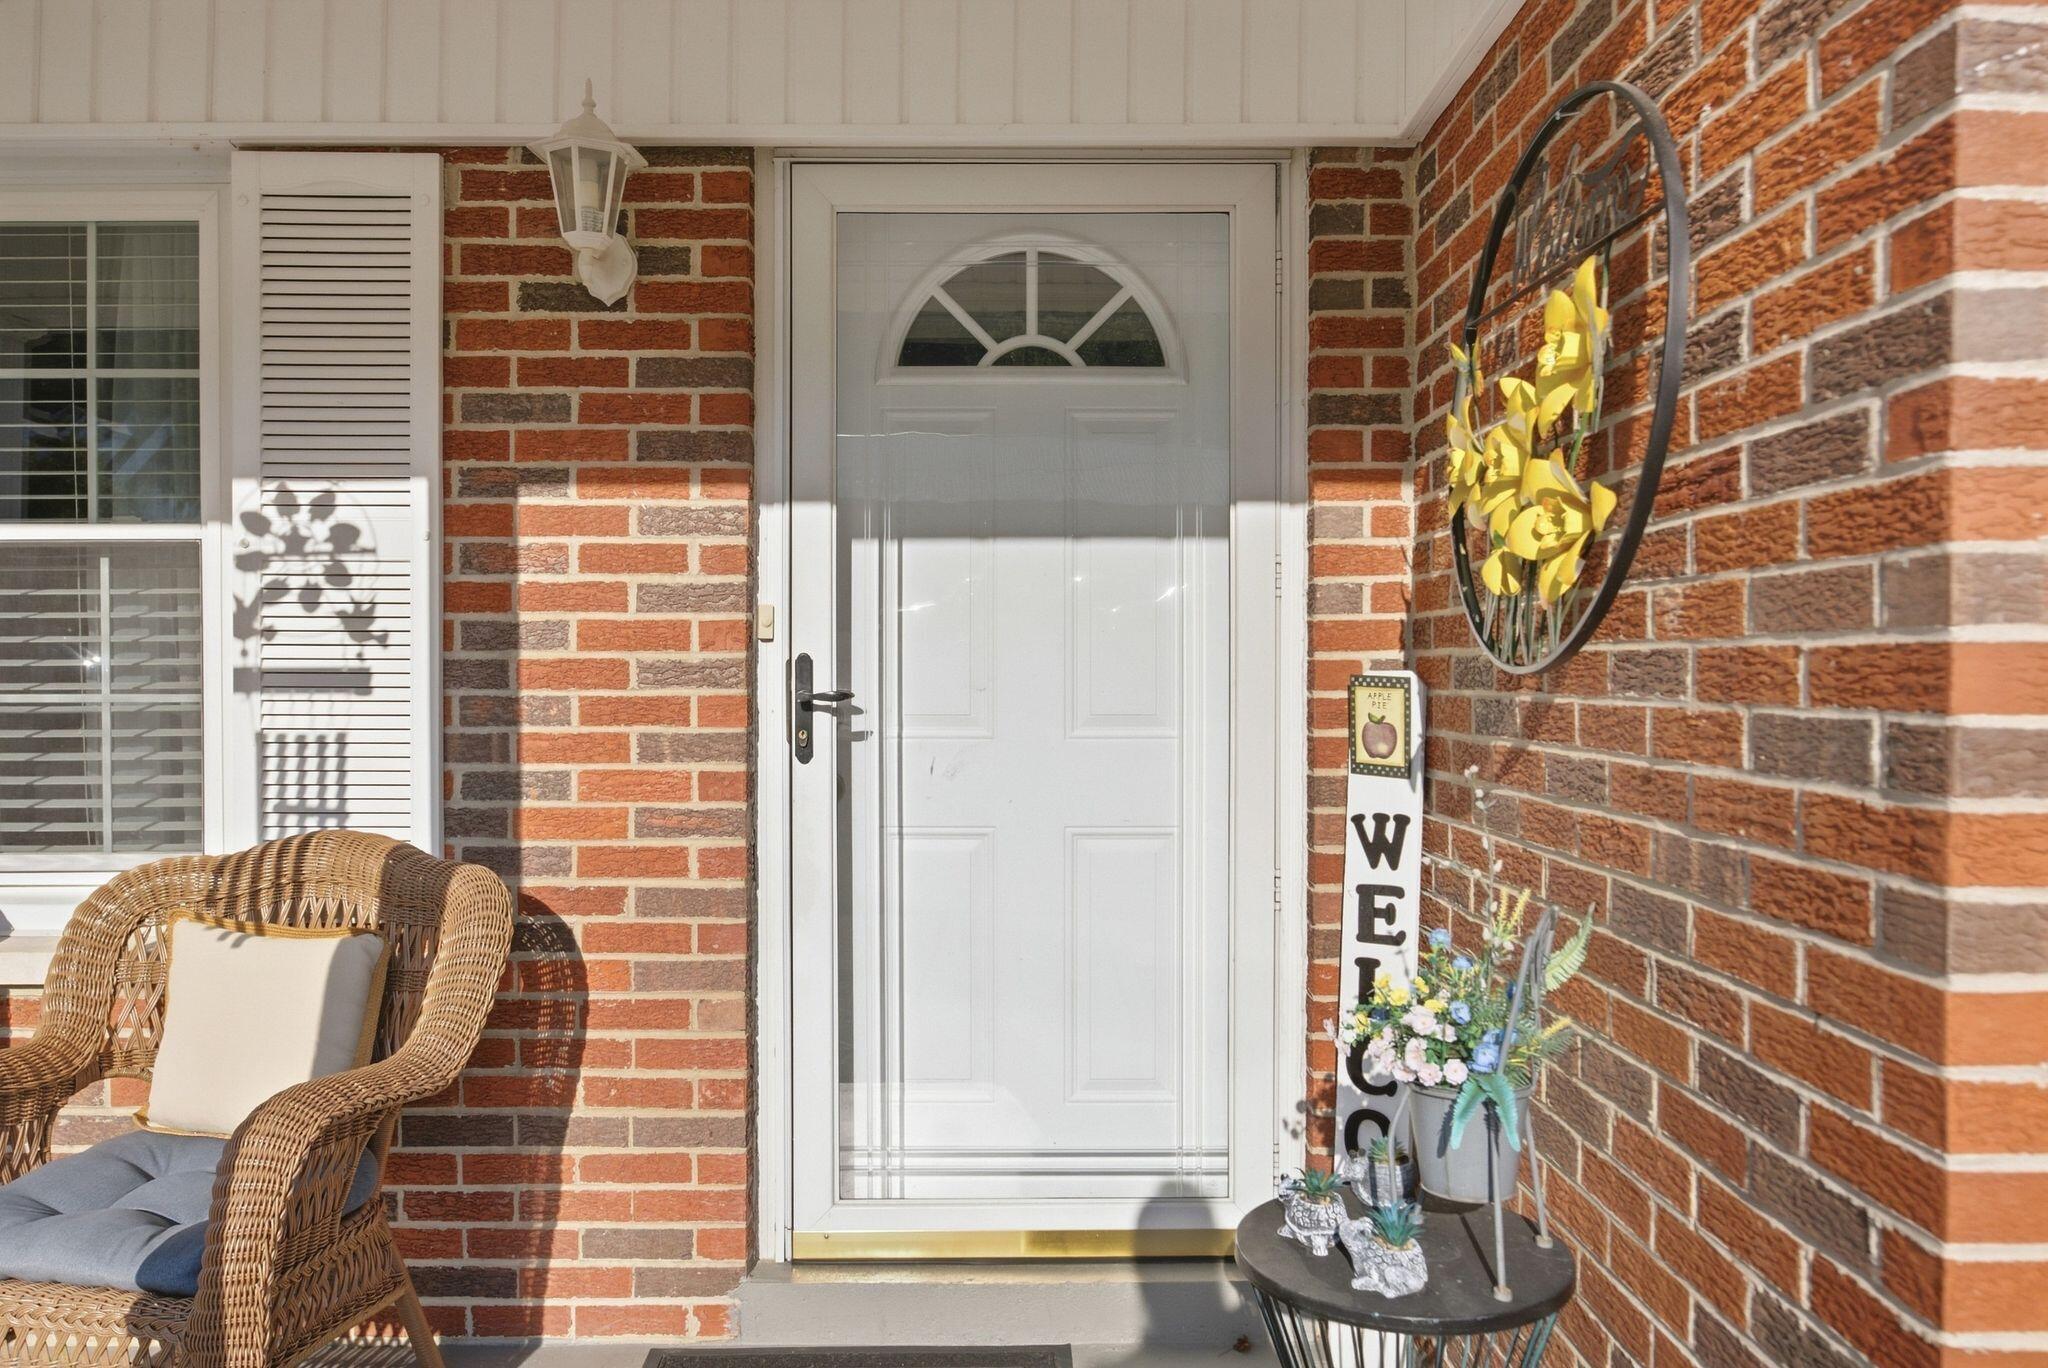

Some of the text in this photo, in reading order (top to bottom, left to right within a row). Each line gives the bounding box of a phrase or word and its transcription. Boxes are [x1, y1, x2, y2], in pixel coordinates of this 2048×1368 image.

[1367, 692, 1392, 701] APPLE
[1371, 701, 1387, 710] PIE
[1343, 812, 1411, 1160] WELCO
